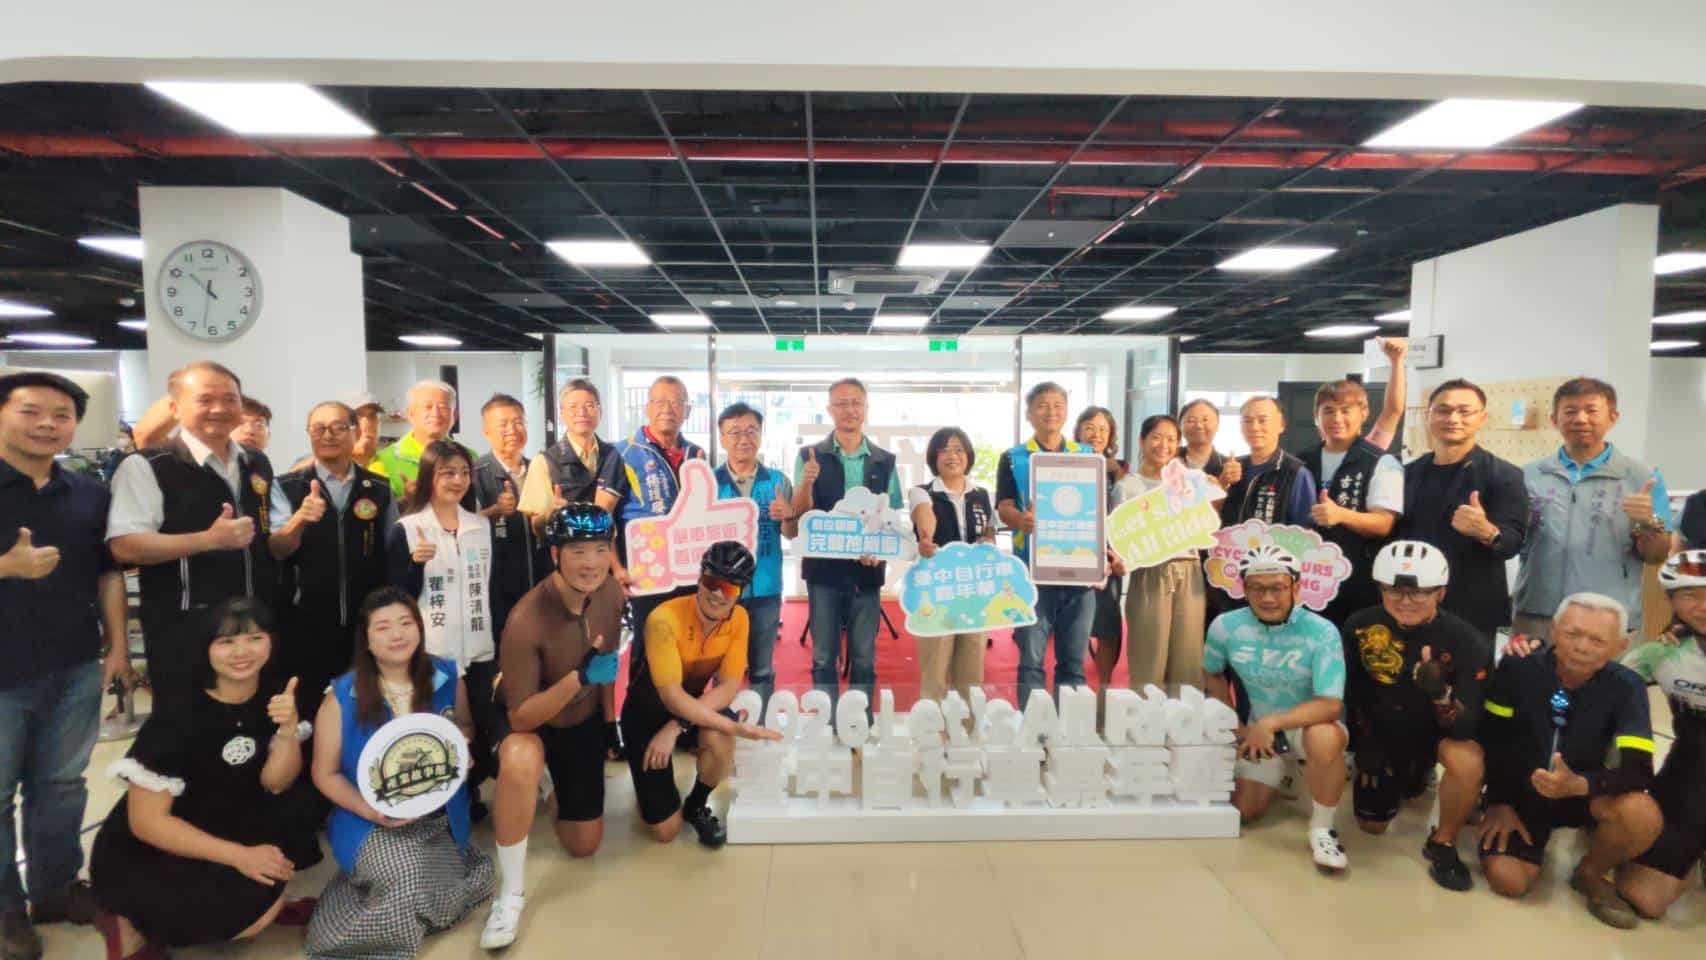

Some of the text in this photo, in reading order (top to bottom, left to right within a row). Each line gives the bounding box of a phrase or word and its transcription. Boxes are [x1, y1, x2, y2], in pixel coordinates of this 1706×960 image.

[202, 249, 214, 258] 12
[239, 267, 249, 277] 2
[167, 287, 177, 297] 9
[244, 287, 253, 297] 3
[174, 306, 184, 317] 8
[239, 306, 249, 315] 4
[227, 320, 237, 330] 5
[207, 326, 218, 336] 6
[1213, 546, 1246, 561] CYC
